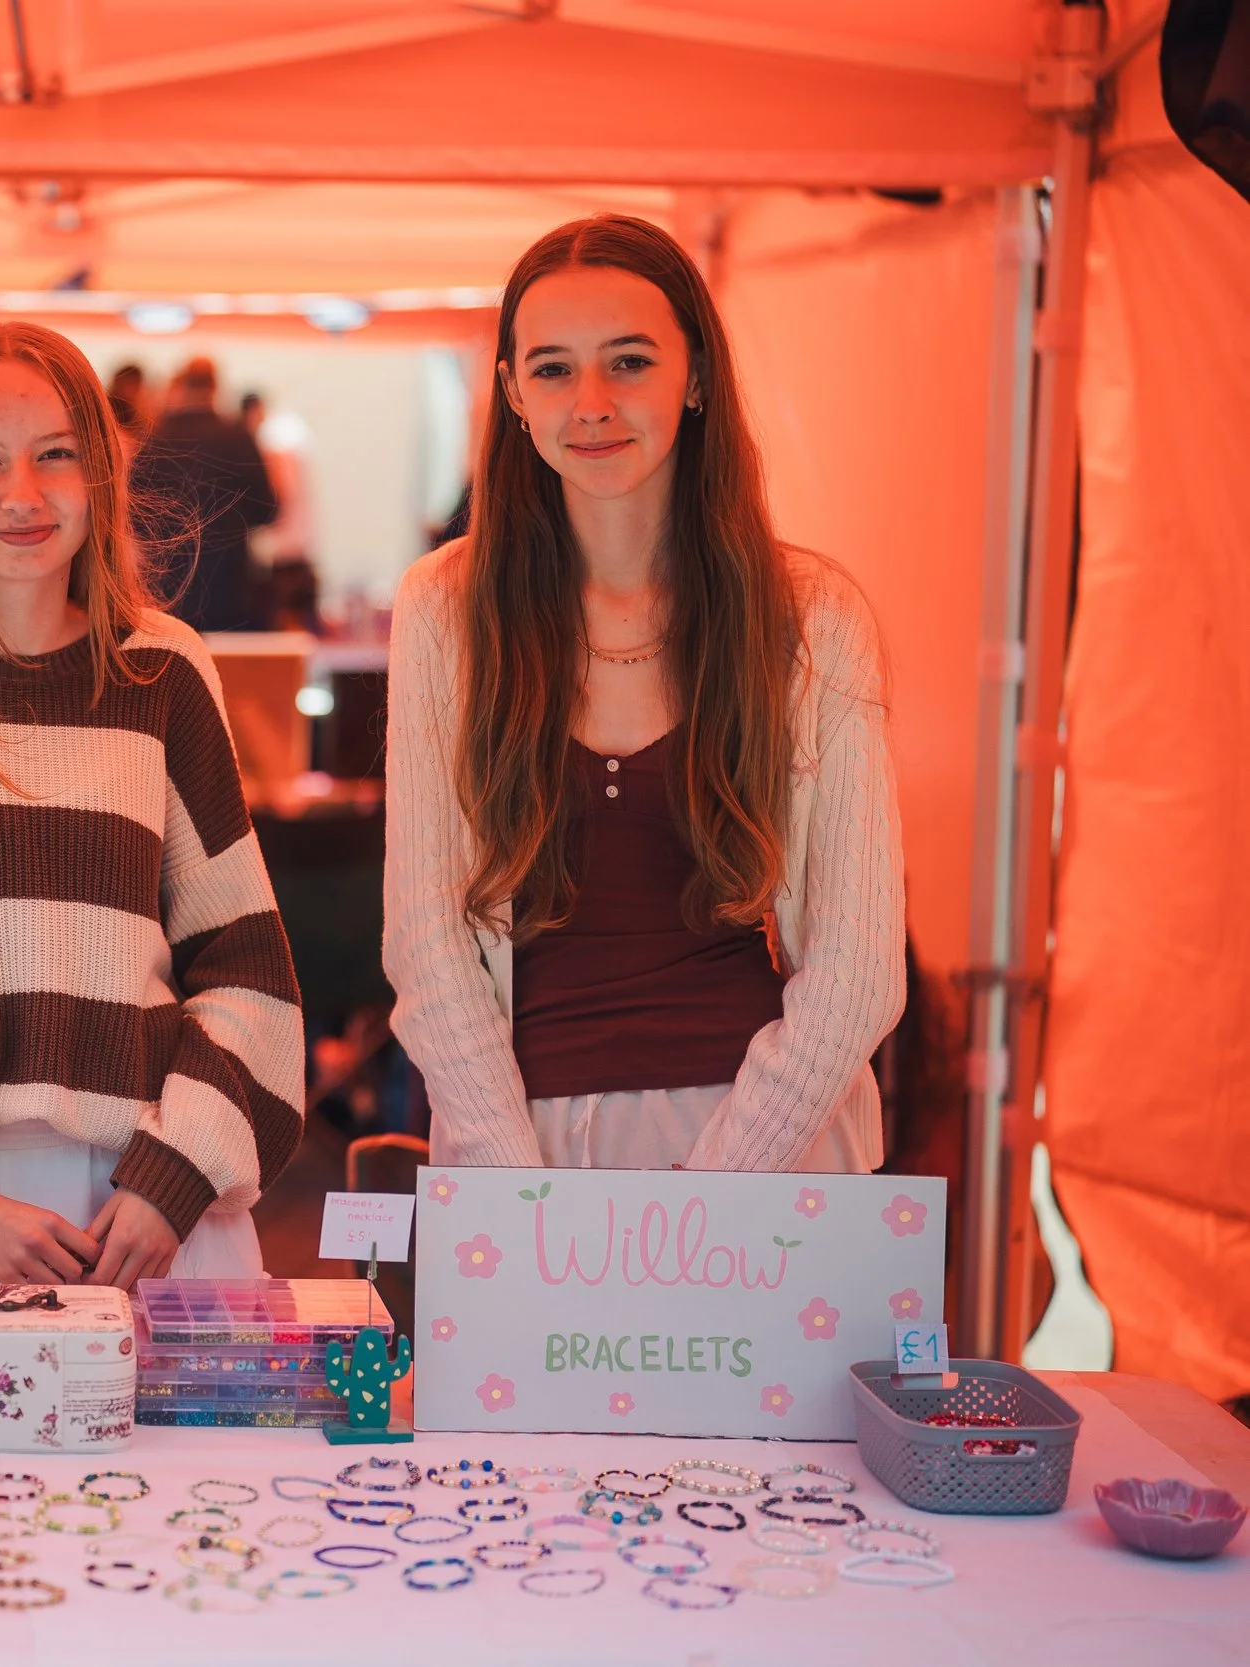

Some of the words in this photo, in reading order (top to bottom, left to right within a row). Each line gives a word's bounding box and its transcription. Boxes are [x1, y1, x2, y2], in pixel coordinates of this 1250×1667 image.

[535, 1196, 788, 1290] Willow
[545, 1332, 753, 1378] BRACELETS
[900, 1330, 939, 1364] £1
